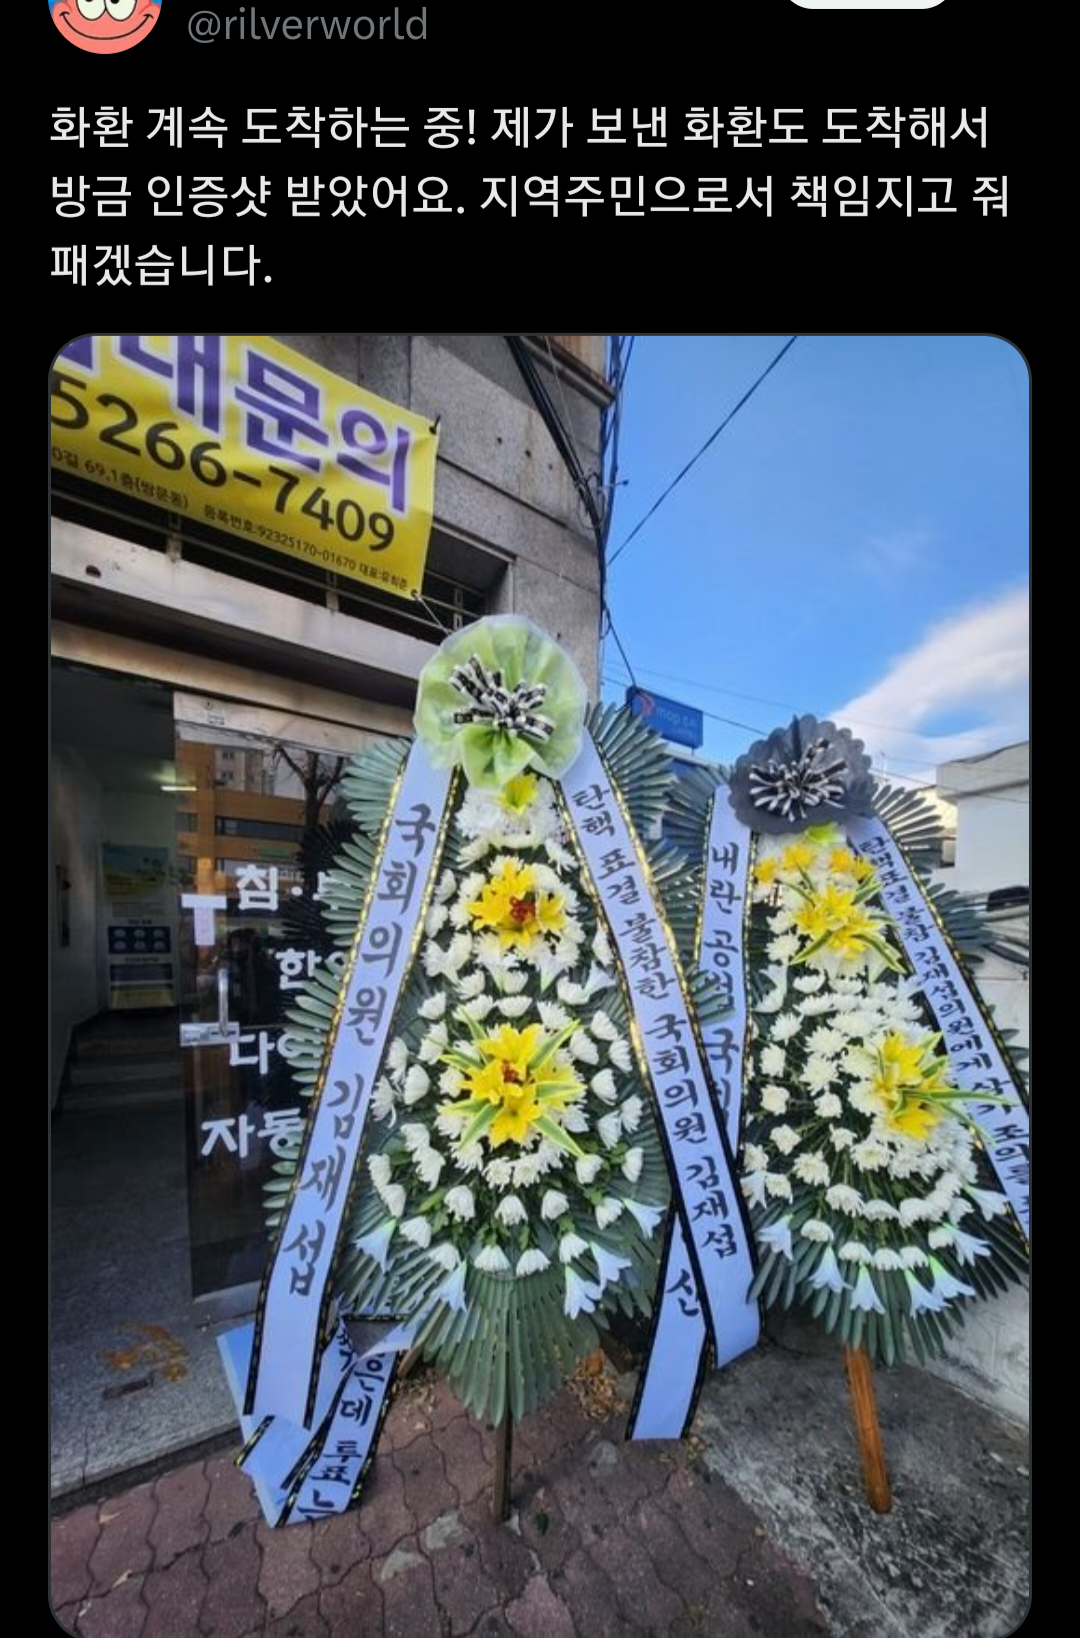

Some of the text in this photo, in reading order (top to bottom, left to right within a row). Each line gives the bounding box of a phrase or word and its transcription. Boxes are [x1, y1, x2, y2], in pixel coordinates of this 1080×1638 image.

[52, 336, 410, 513] 대문의
[572, 784, 738, 1259] 탄핵 표결 불참한 국회의원 김재섭
[711, 842, 742, 915] 내란
[284, 803, 436, 1297] 국회의원 김재섭
